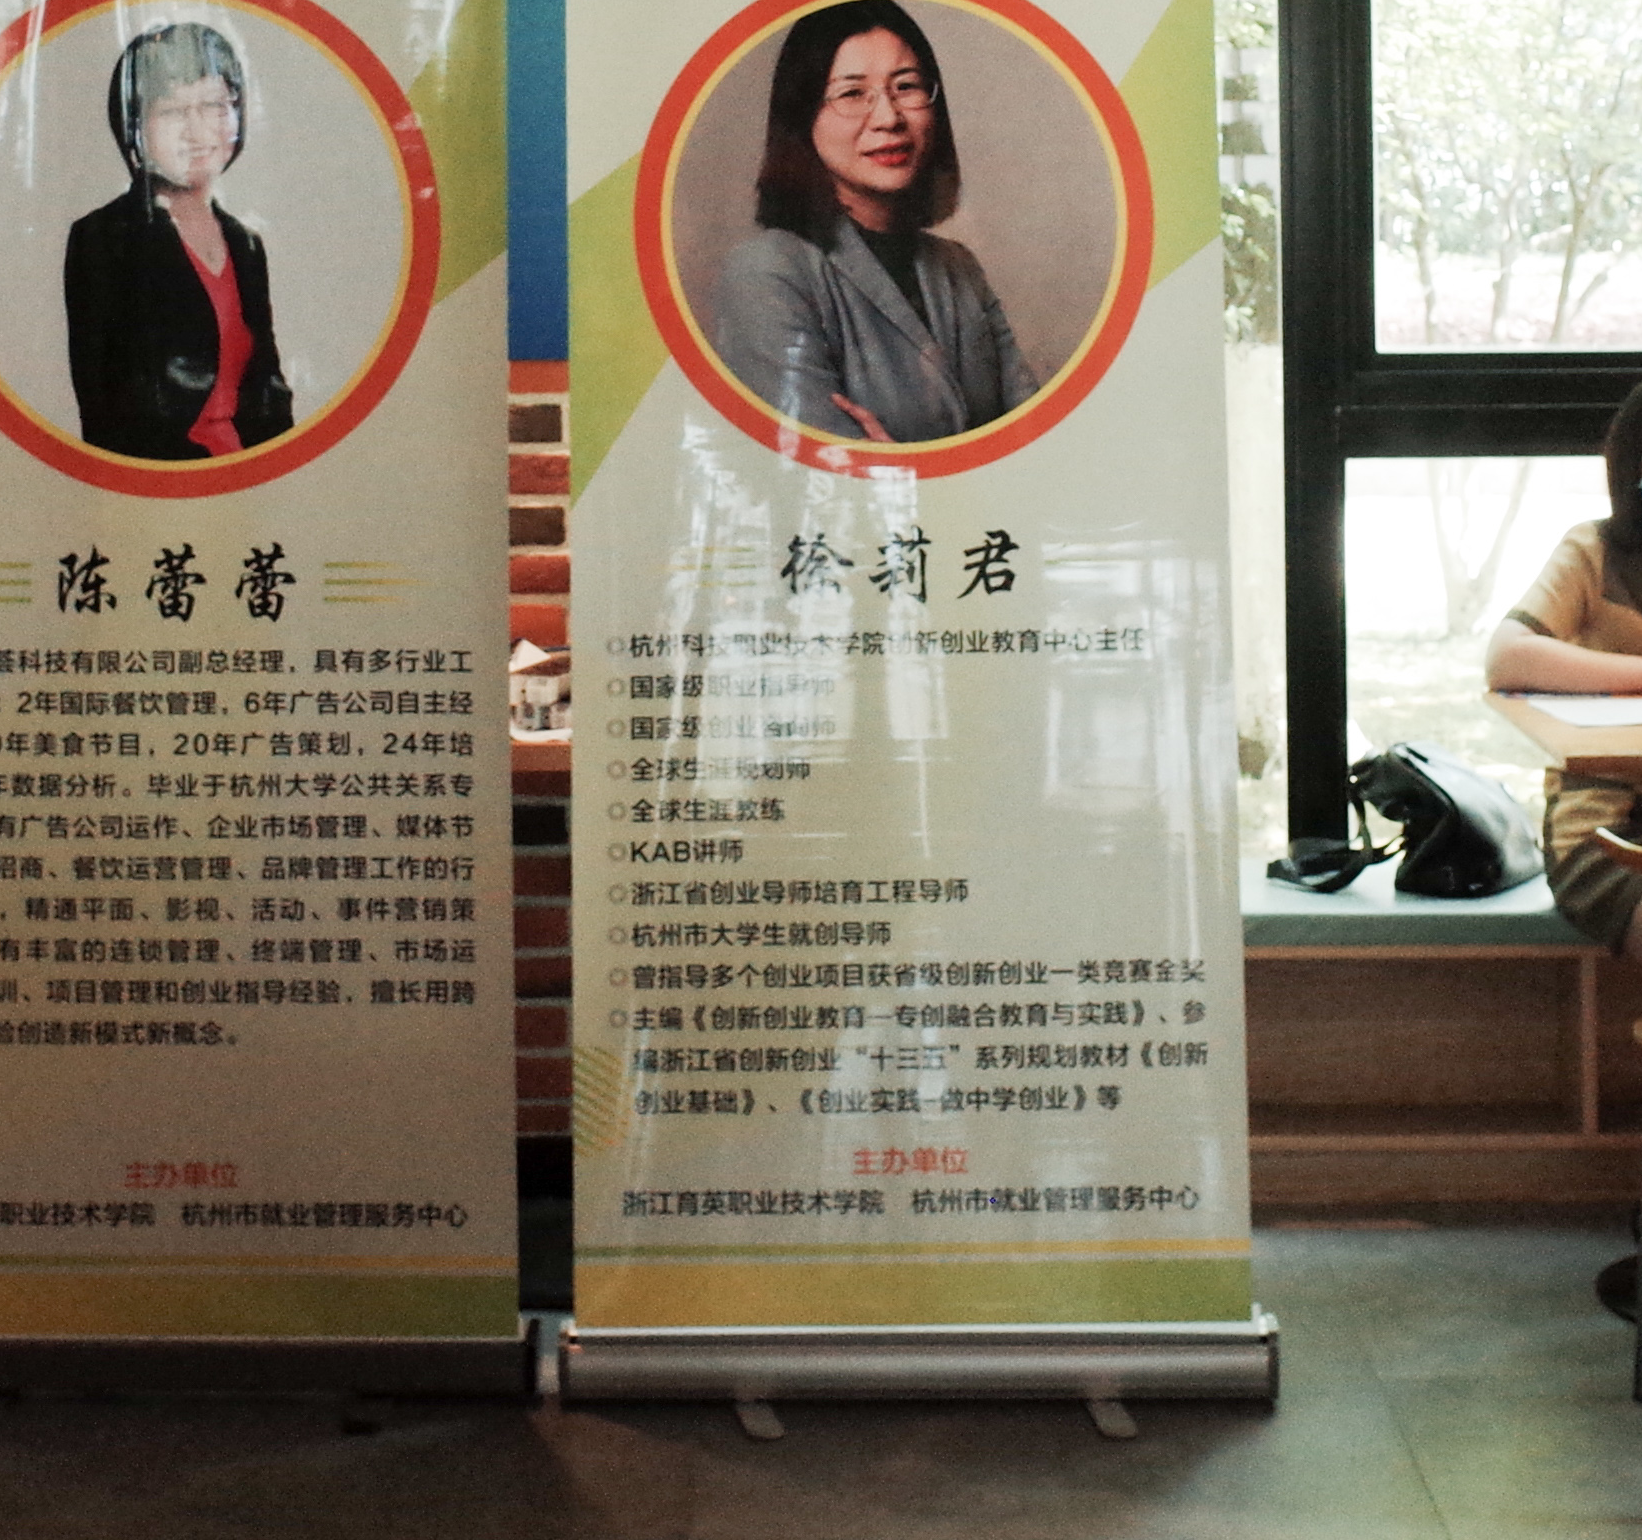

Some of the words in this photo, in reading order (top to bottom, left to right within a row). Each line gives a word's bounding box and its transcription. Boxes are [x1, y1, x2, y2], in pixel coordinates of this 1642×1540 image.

[779, 525, 1022, 605] 徐莉君
[56, 541, 297, 624] 陈蕾蕾
[630, 798, 786, 825] 全球生涯教练
[630, 840, 744, 865] KAB讲师
[631, 877, 970, 907] 浙江省创业导师培育工程导师
[632, 920, 893, 948] 杭州市大学生就创导师
[124, 1162, 239, 1190] 主办单位
[853, 1147, 969, 1176] 主办单位
[181, 1200, 469, 1229] 杭州市就业管理服务中心
[622, 1188, 885, 1218] 浙江育英职业技术学院
[910, 1184, 1201, 1216] 杭州市就业管理服务中心
